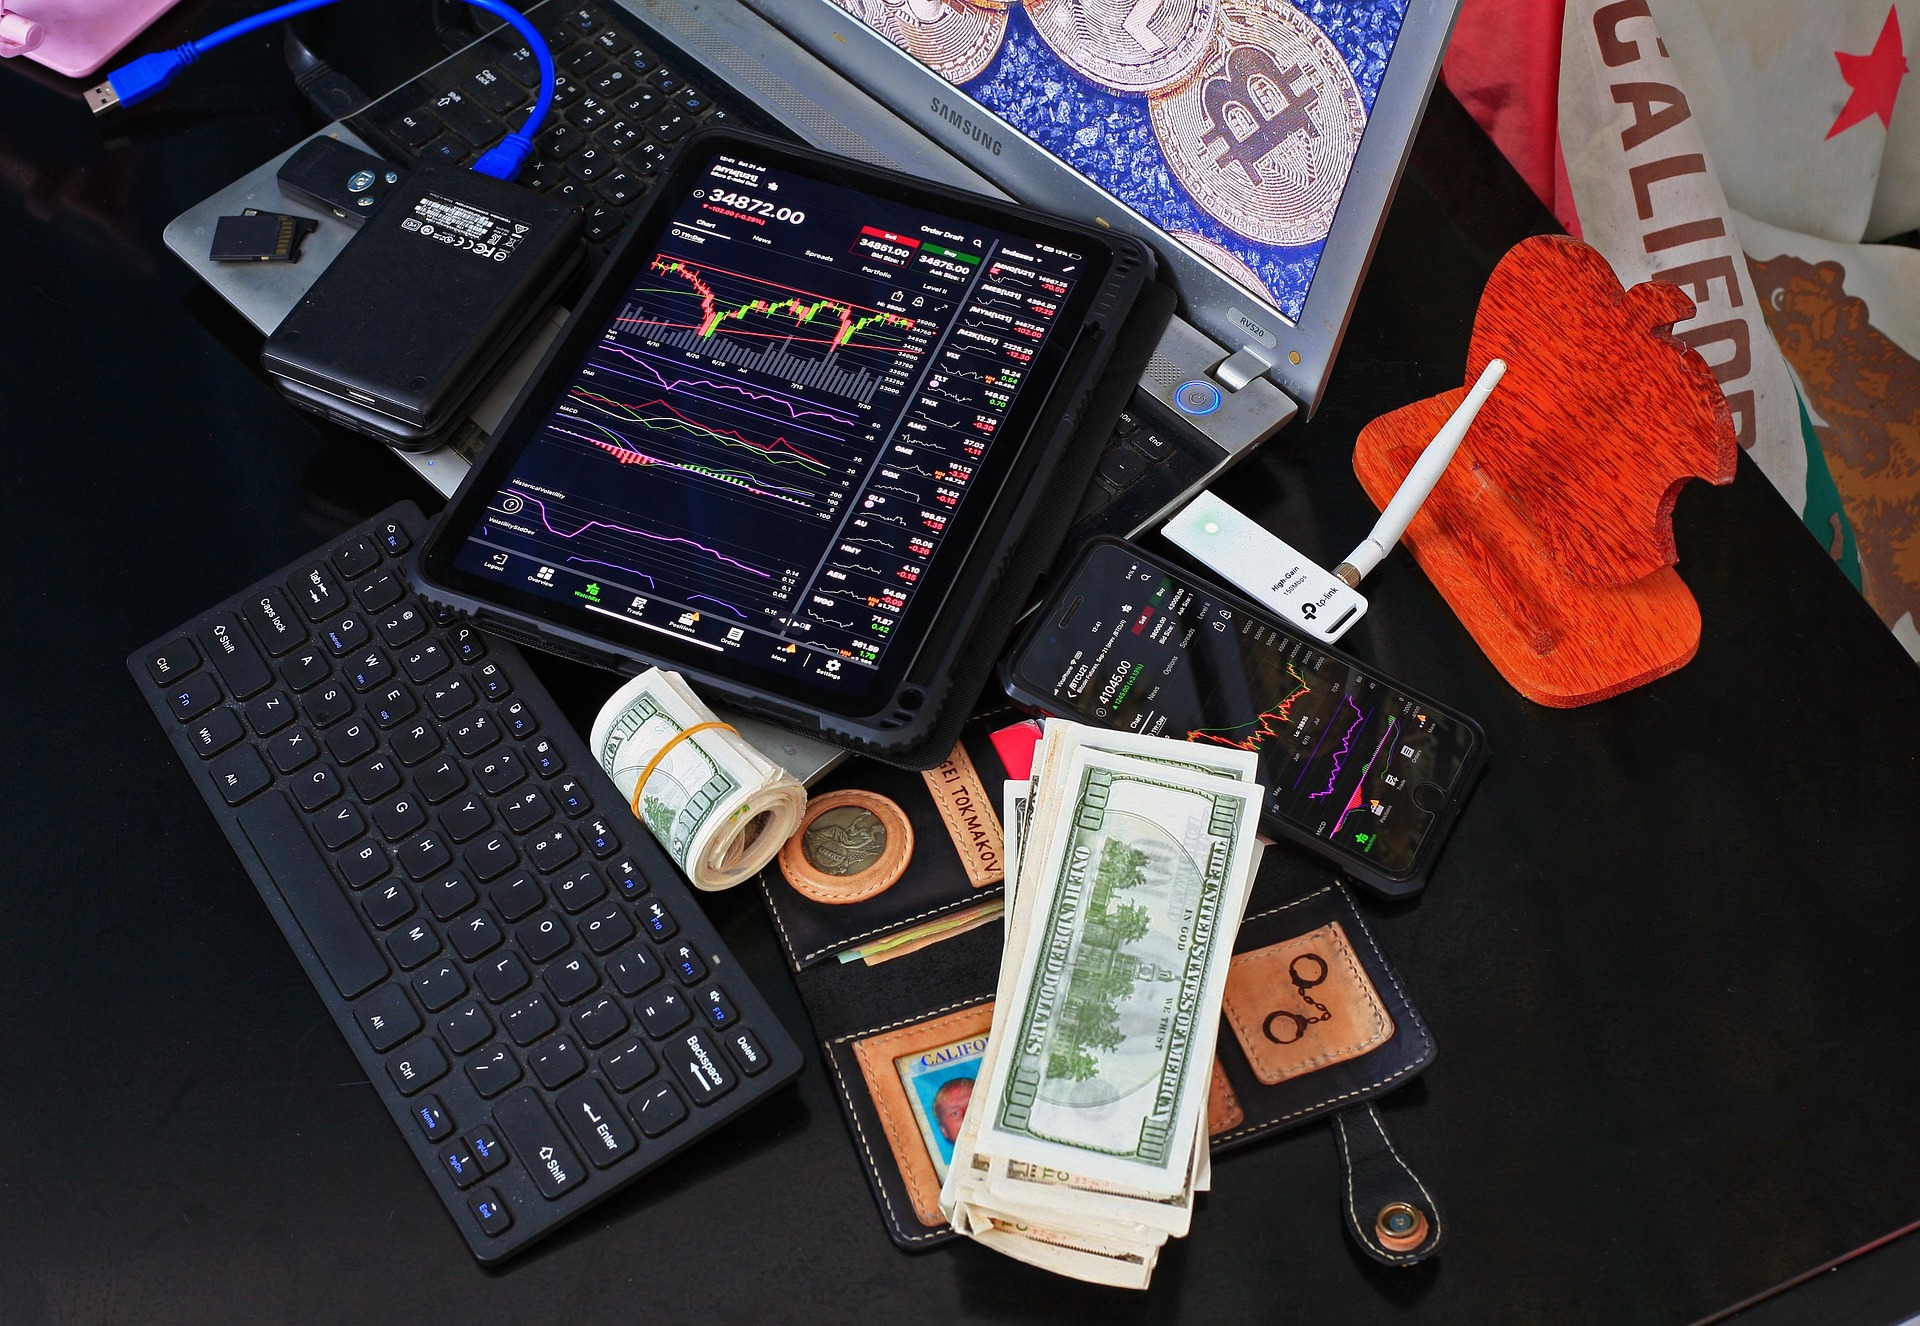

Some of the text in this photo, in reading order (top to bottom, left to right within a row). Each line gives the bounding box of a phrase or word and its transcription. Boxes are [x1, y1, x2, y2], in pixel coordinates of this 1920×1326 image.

[403, 116, 417, 128] Ctrl
[930, 97, 1002, 157] SAMSUNG
[708, 188, 806, 226] 34872.00
[696, 218, 717, 229] Chart
[752, 234, 772, 245] News
[884, 232, 898, 241] Sell
[920, 224, 965, 242] Order Draft
[859, 237, 910, 258] 34851.00
[943, 249, 958, 258] Buy
[1001, 247, 1034, 262] Indexes
[804, 249, 834, 263] Spreads
[883, 254, 900, 265] Size:
[861, 265, 892, 279] Portfolio
[918, 254, 970, 276] 34875.00
[942, 271, 960, 282] Size:
[922, 282, 942, 294] Level
[1240, 317, 1265, 338] RV520
[946, 350, 961, 360] VIX
[933, 374, 949, 383] TLT
[559, 404, 579, 415] MACD
[921, 397, 939, 408] TNX
[989, 398, 1007, 408] 0.70
[907, 421, 928, 432] AMC
[972, 421, 994, 432] -0.30
[976, 414, 997, 426] 12.39
[963, 438, 985, 450] 37.02
[1148, 435, 1164, 448] End
[963, 446, 982, 456] -1.11
[512, 478, 566, 500] HistoricalVolatility
[936, 487, 960, 499] 34.92
[936, 494, 957, 506] -0.15
[488, 516, 536, 536] VolatilityStdDev
[840, 544, 861, 555] HMY
[484, 561, 504, 572] Logout
[309, 569, 321, 585] Tab
[527, 575, 554, 588] Overview
[826, 570, 847, 581] AEM
[1271, 565, 1300, 592] High-Gain
[1283, 574, 1308, 597] 150Mbps
[574, 590, 601, 604] Watchlist
[1315, 585, 1339, 608] tp-link
[260, 597, 277, 618] Caps
[626, 607, 643, 617] Trade
[1197, 605, 1209, 620] Level
[341, 619, 354, 631] Q
[669, 620, 696, 634] Positions
[871, 614, 894, 626] 71.87
[871, 623, 889, 634] 0.42
[219, 635, 236, 654] Shift
[720, 637, 741, 648] Orders
[1180, 627, 1196, 649] Spreads
[156, 657, 171, 673] Ctrl
[300, 655, 314, 667] A
[364, 653, 380, 668] W
[770, 653, 787, 663] More
[1163, 655, 1179, 676] Options
[816, 667, 841, 680] Settings
[1069, 663, 1089, 691] /BTCU21
[488, 681, 498, 692] F4
[1099, 659, 1132, 705] 41045.00
[178, 692, 190, 707] Fn
[386, 689, 401, 701] E
[1147, 684, 1160, 702] News
[513, 719, 524, 730] F5
[1129, 713, 1144, 730] Chart
[199, 727, 212, 745] Win
[411, 726, 425, 739] R
[540, 757, 550, 769] F6
[225, 772, 238, 787] Alt
[395, 800, 409, 814] G
[567, 797, 578, 807] F7
[952, 785, 1002, 872] TOKMAKOV
[1315, 820, 1328, 836] MACD
[419, 838, 434, 853] H
[594, 837, 606, 849] F8
[359, 847, 374, 860] B
[1069, 845, 1091, 883] ONE
[623, 878, 635, 890] F9
[539, 920, 553, 933] O
[650, 917, 663, 931] F10
[1177, 908, 1194, 952] IN GOD
[566, 960, 580, 972] P
[681, 962, 694, 976] F11
[711, 1006, 725, 1021] F12
[1154, 1015, 1170, 1052] TRUST
[736, 1035, 758, 1063] Delete
[921, 1036, 991, 1067] CALIFO
[686, 1034, 724, 1086] Backspace
[399, 1060, 416, 1080] Ctrl
[420, 1107, 436, 1129] Home
[596, 1122, 618, 1150] Enter
[475, 1138, 489, 1157] PgUp
[448, 1154, 464, 1175] PgDn
[546, 1159, 567, 1184] Shift
[478, 1202, 492, 1219] End
